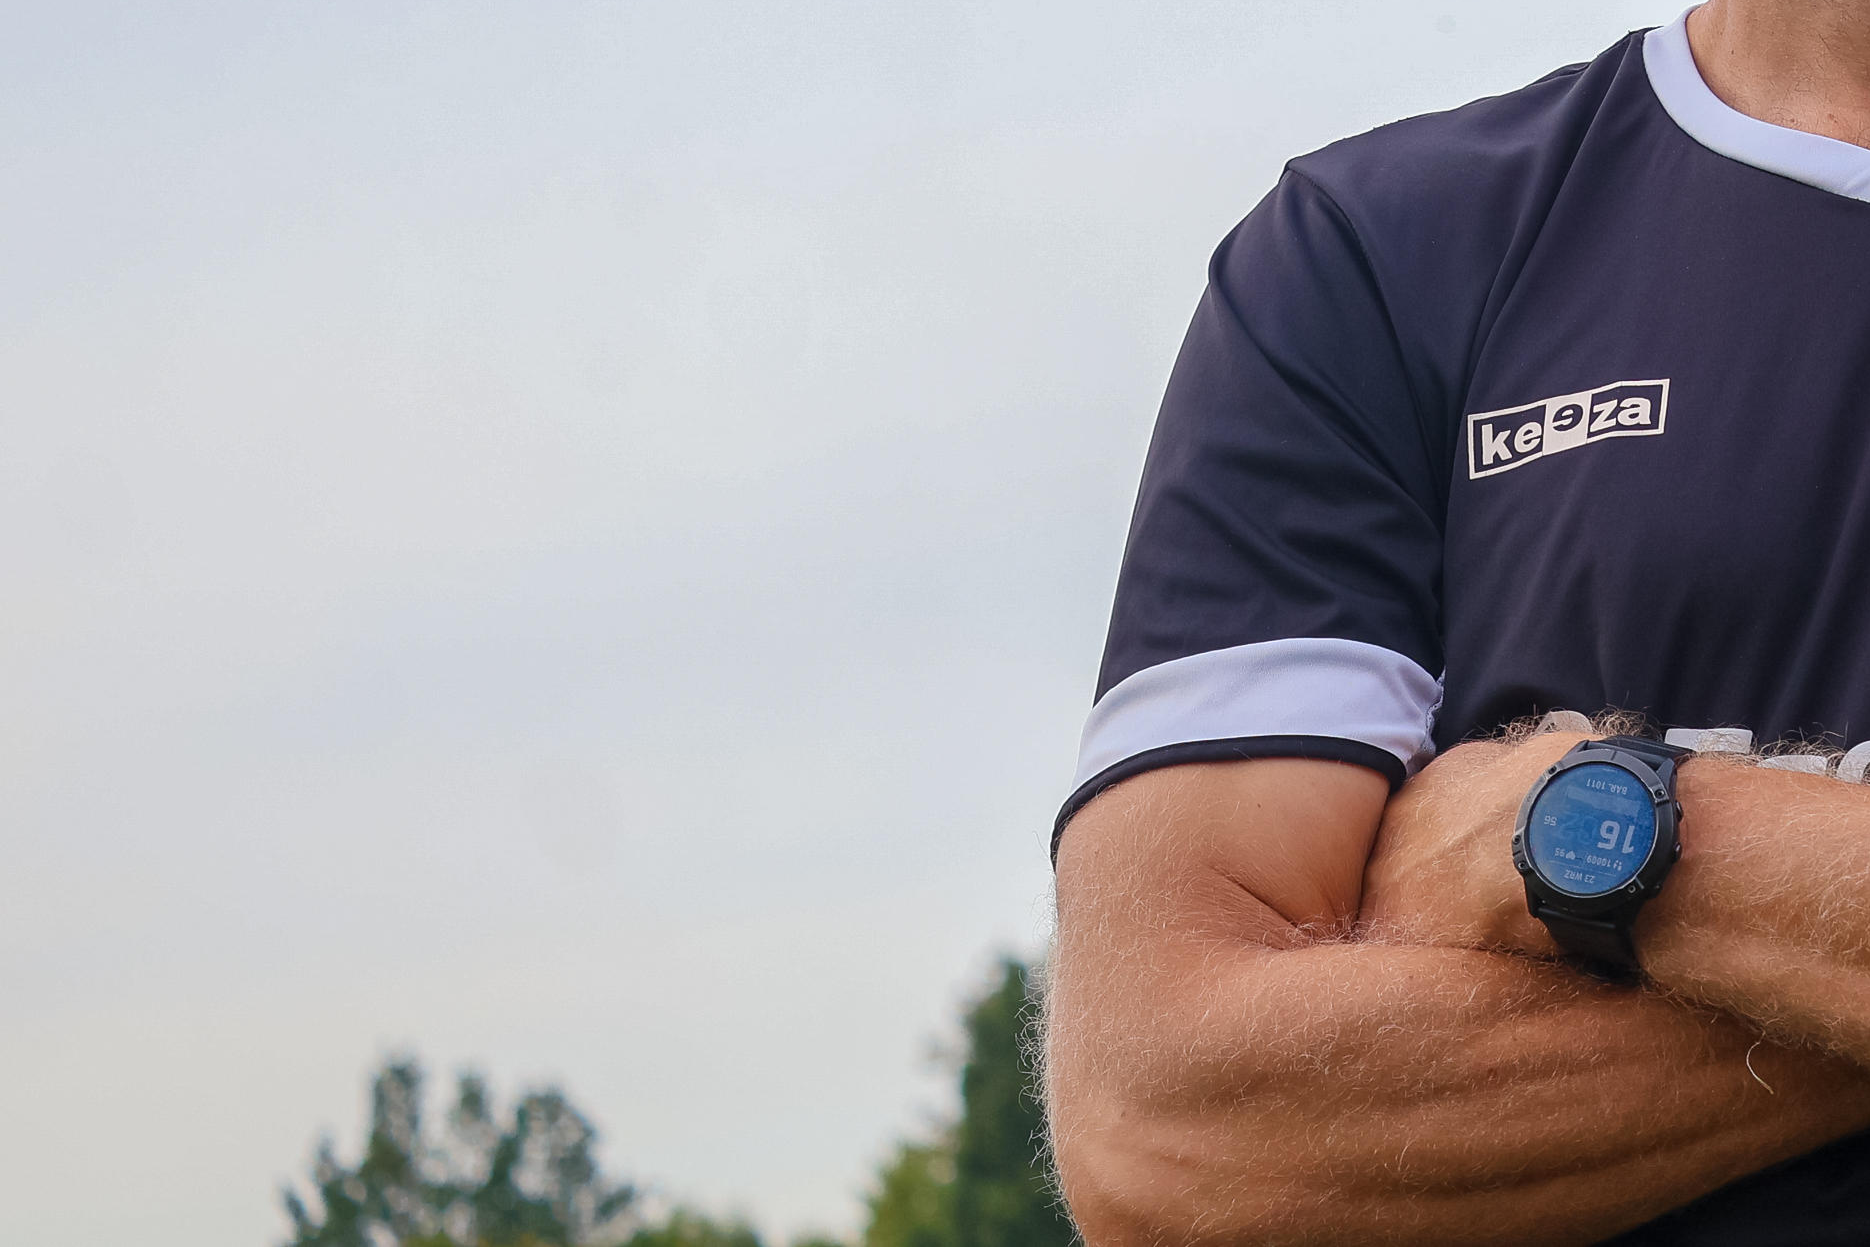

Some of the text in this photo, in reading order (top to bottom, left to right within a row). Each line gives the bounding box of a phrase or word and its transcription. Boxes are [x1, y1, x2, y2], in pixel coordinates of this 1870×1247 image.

[1586, 778, 1606, 790] 1011
[1543, 815, 1558, 827] 56
[1597, 820, 1635, 854] 16
[1564, 869, 1596, 884] 23 WRZ
